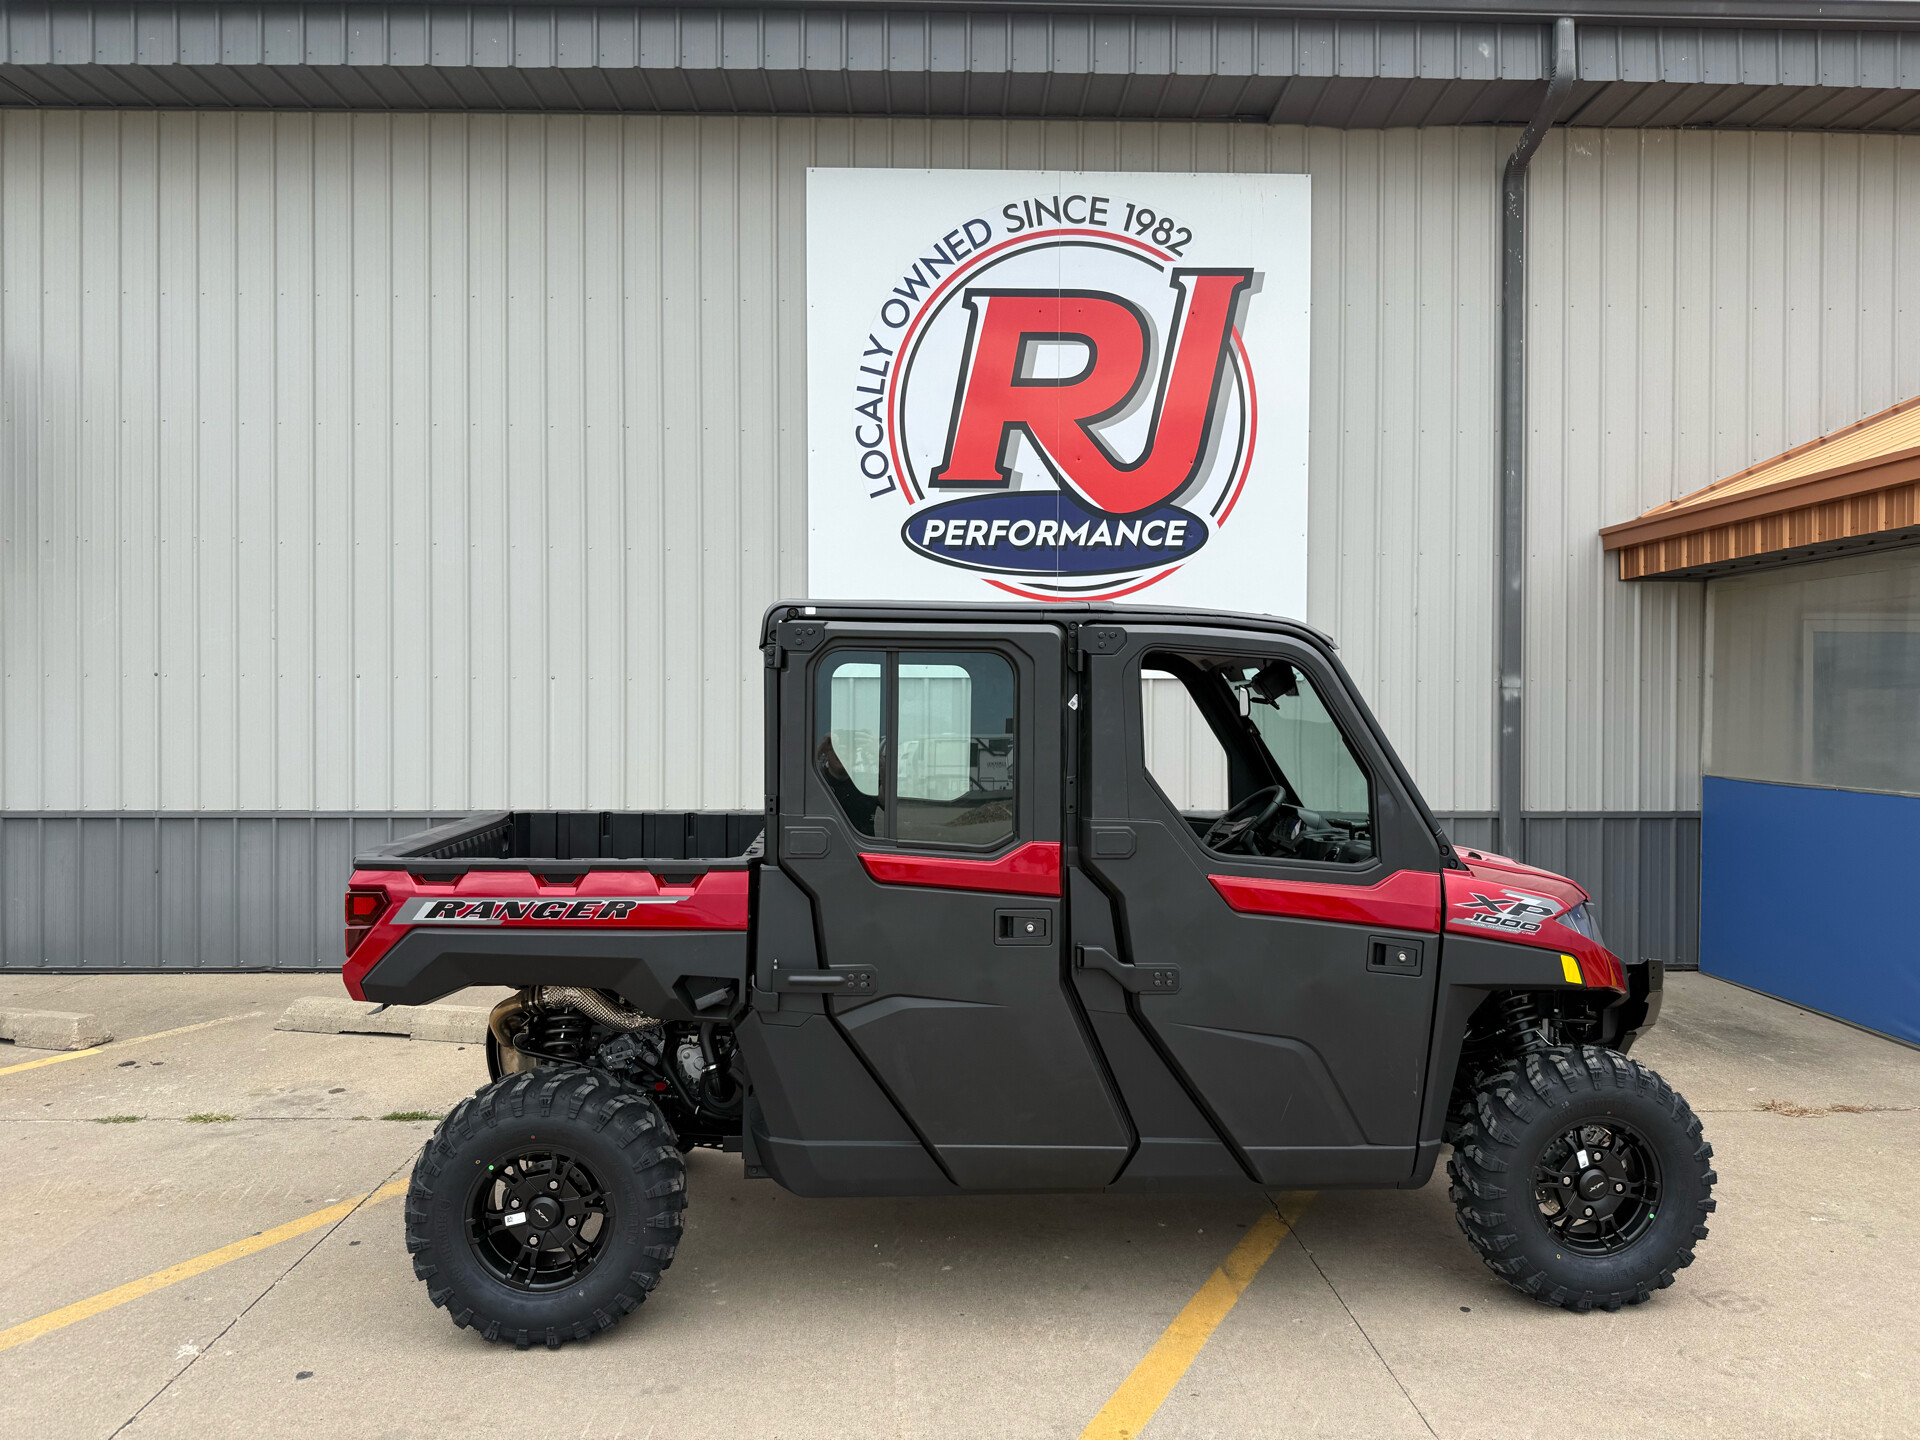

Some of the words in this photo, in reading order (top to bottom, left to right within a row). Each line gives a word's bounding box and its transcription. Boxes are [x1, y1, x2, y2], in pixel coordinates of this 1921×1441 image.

[855, 333, 898, 499] LOCALLY
[881, 218, 992, 330] OWNED
[1002, 194, 1110, 234] SINCE
[1123, 202, 1193, 258] 1982
[928, 266, 1256, 515] RJ
[922, 519, 1188, 547] PERFORMANCE
[424, 900, 638, 920] RANGER
[1454, 892, 1556, 917] XP
[1472, 912, 1542, 933] 1000
